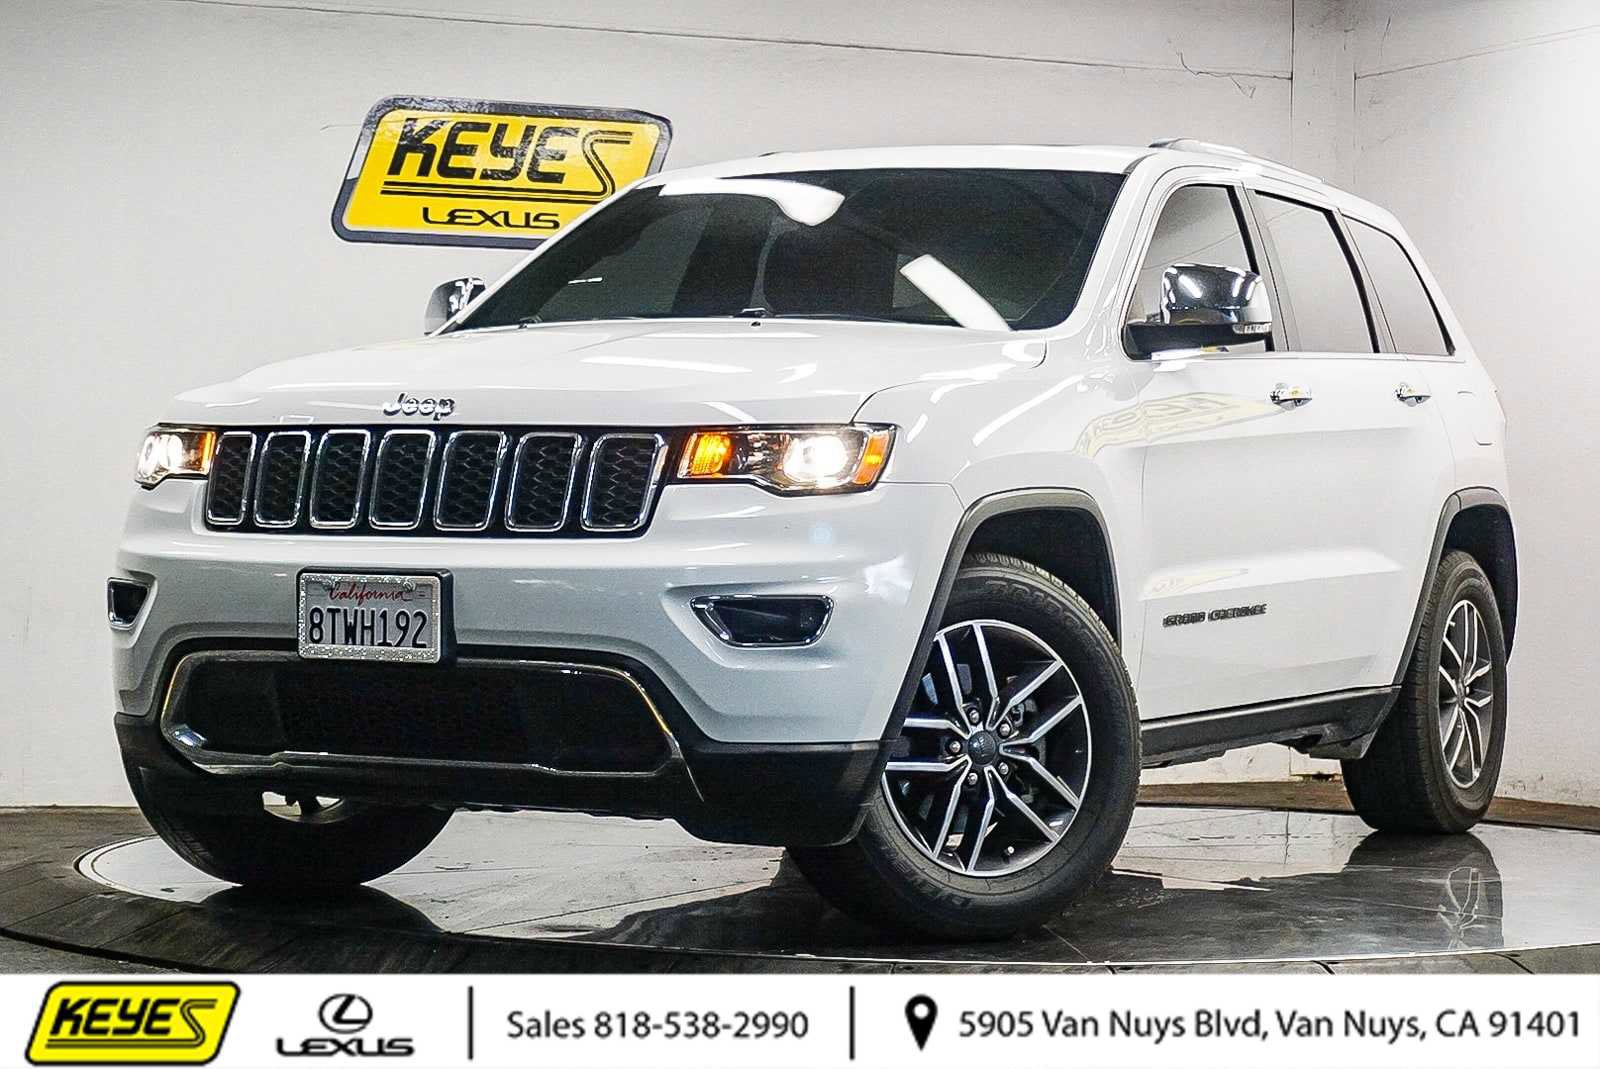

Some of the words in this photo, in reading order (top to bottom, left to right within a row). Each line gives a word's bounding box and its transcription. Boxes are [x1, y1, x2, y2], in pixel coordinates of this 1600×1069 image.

[386, 117, 633, 202] KEYES
[422, 206, 560, 230] LEXUS
[382, 392, 455, 421] Jeep
[329, 582, 405, 606] California
[309, 606, 428, 648] 8TWH192
